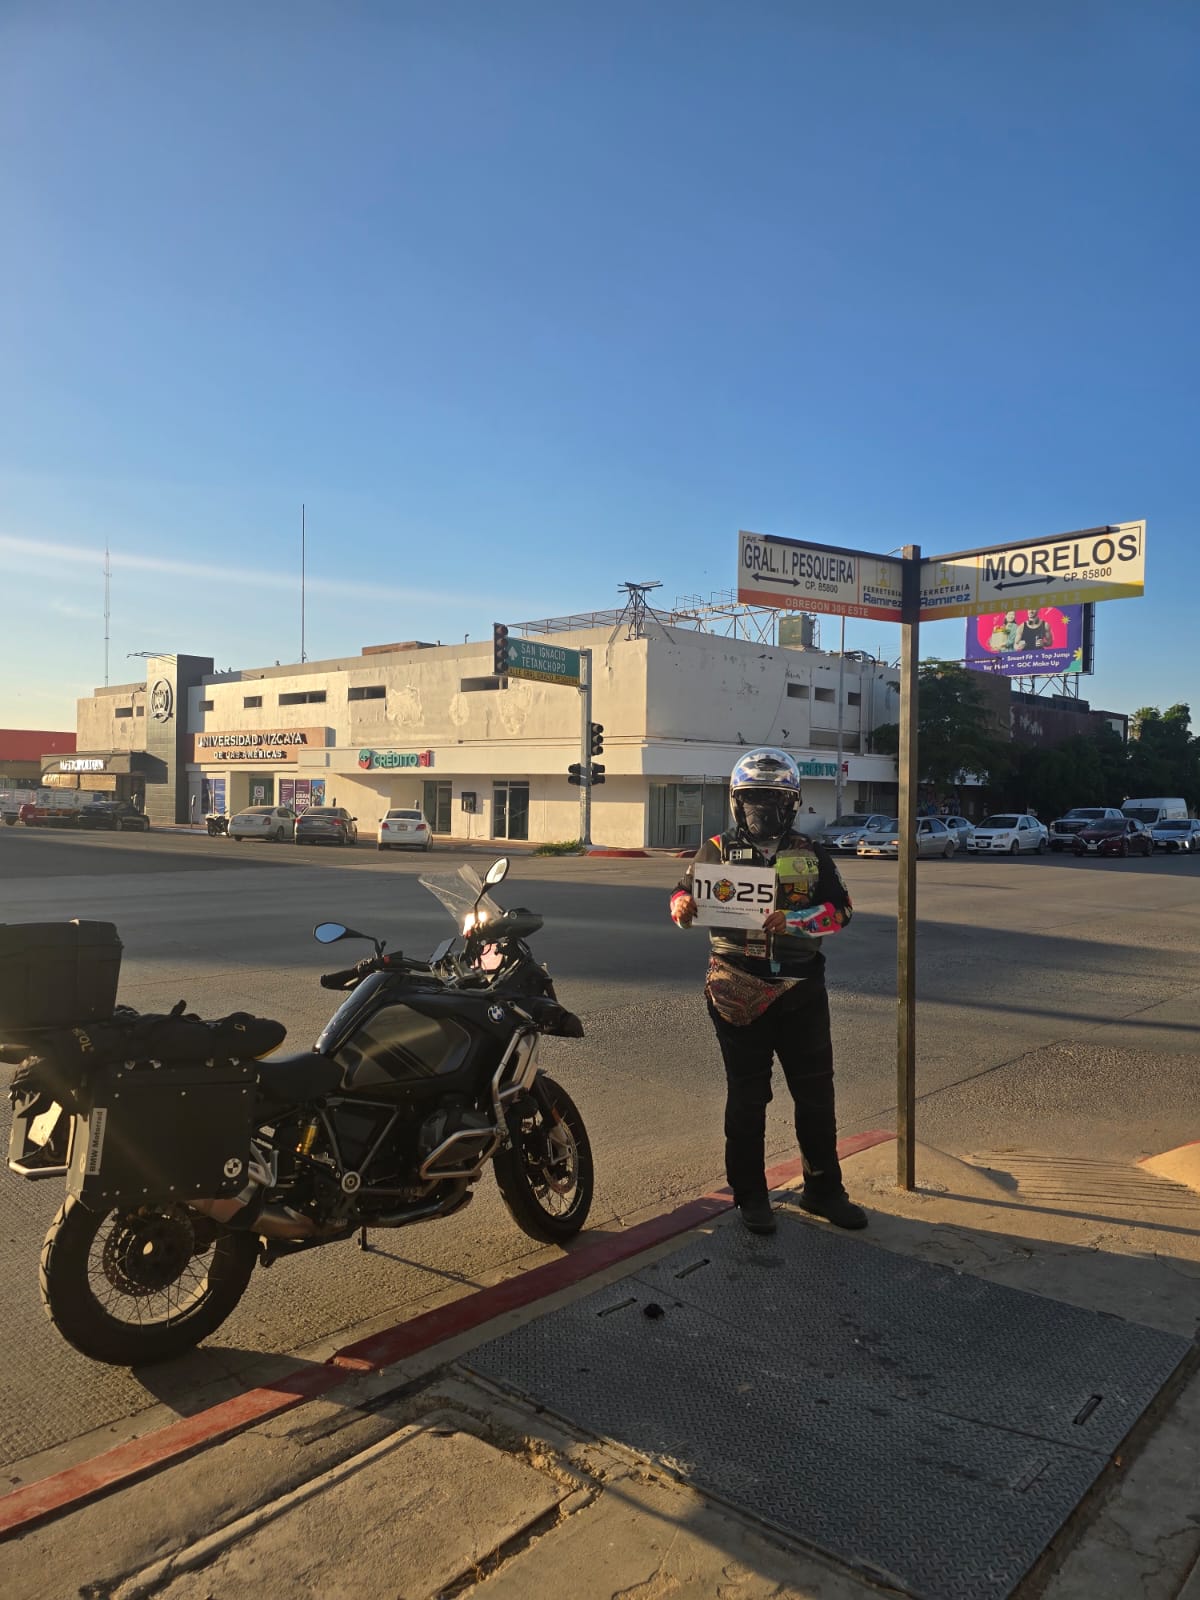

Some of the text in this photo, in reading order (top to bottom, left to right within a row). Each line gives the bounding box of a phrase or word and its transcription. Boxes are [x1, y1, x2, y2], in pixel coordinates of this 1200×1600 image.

[744, 543, 779, 573] GRAL.
[791, 551, 854, 585] PESQUEIRA
[985, 535, 1137, 582] MORELOS
[1082, 567, 1112, 580] 85800
[818, 582, 838, 594] 85800
[785, 598, 830, 612] OBREGON
[848, 606, 869, 616] ESTE
[521, 643, 566, 661] SAN IGNACIO
[373, 751, 418, 767] CRÉDITO
[737, 882, 773, 904] 25
